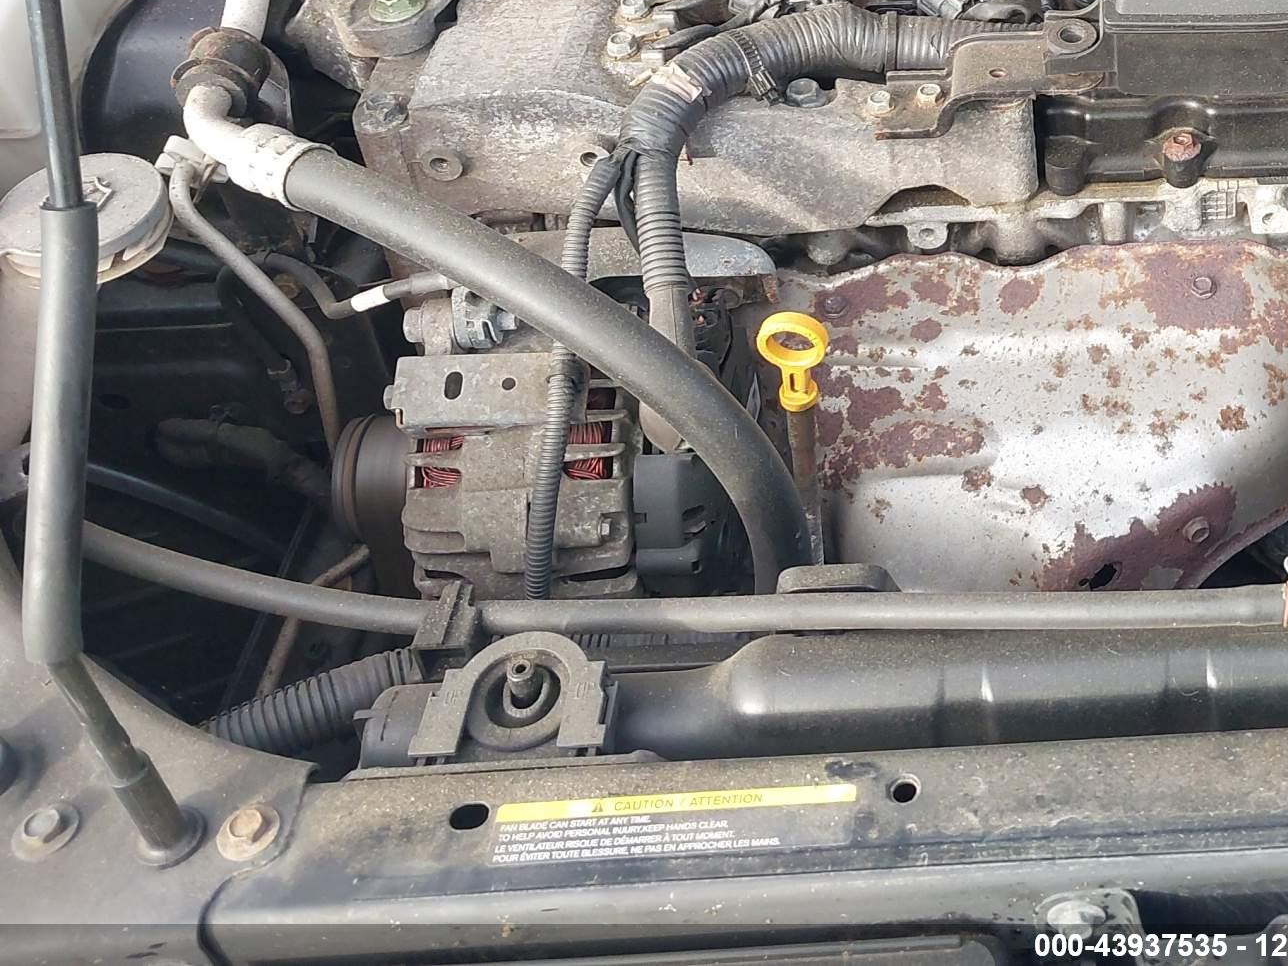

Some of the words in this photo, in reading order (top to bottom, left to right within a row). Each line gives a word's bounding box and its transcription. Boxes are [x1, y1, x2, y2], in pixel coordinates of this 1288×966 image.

[614, 798, 673, 811] CAUTION
[689, 793, 763, 806] ATTENTION
[499, 834, 511, 842] TO
[511, 831, 535, 841] HELP
[535, 830, 563, 840] AVOID
[564, 827, 611, 838] PERSONAL
[666, 821, 697, 831] HANDS
[500, 823, 518, 832] FAN
[519, 821, 547, 831] BLADE
[548, 819, 568, 829] CAN
[570, 817, 597, 827] START
[597, 817, 610, 826] AT
[609, 816, 631, 825] ANY
[492, 854, 519, 863] POUR
[519, 851, 550, 862] ÉVITER
[551, 849, 580, 859] TOUTE
[630, 844, 643, 854] NE
[644, 843, 662, 853] PAS
[663, 842, 676, 852] EN
[676, 840, 732, 852] APPROCHER
[733, 839, 750, 848] LES
[494, 844, 506, 854] LE
[507, 841, 564, 852] VENTILATEUR
[565, 838, 600, 849] RISQUE
[600, 837, 613, 846] DE
[613, 834, 663, 846] DÉMARRER
[672, 832, 695, 842] TOUT
